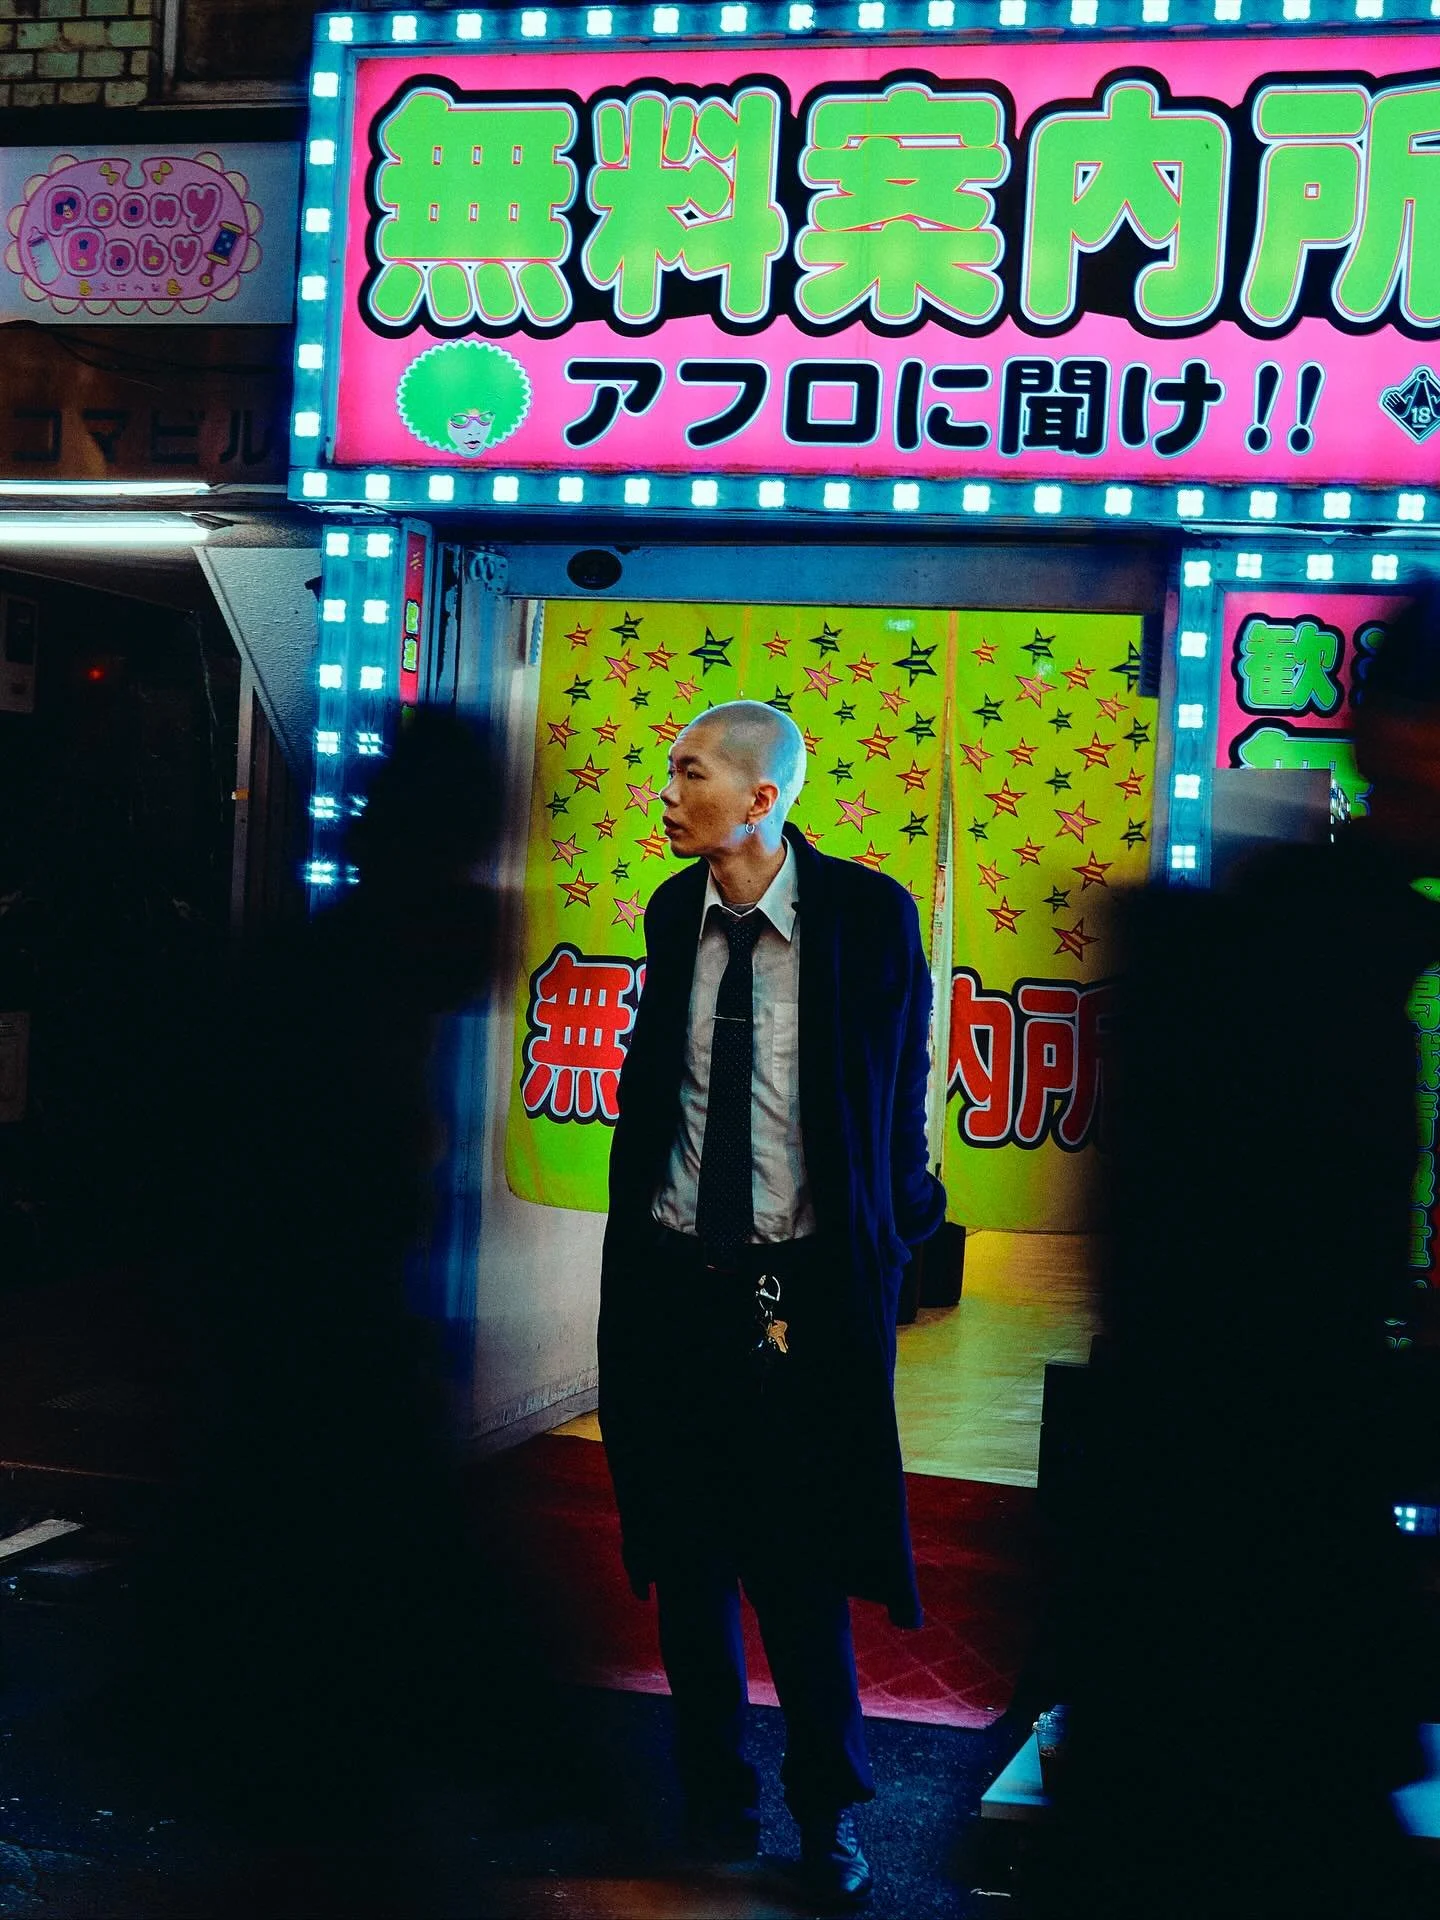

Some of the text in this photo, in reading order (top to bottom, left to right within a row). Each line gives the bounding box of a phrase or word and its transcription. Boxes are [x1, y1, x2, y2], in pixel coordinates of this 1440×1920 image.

[45, 183, 222, 236] Poony
[366, 78, 1440, 328] 無料案内所
[62, 228, 202, 276] Baby
[1411, 405, 1432, 424] 18
